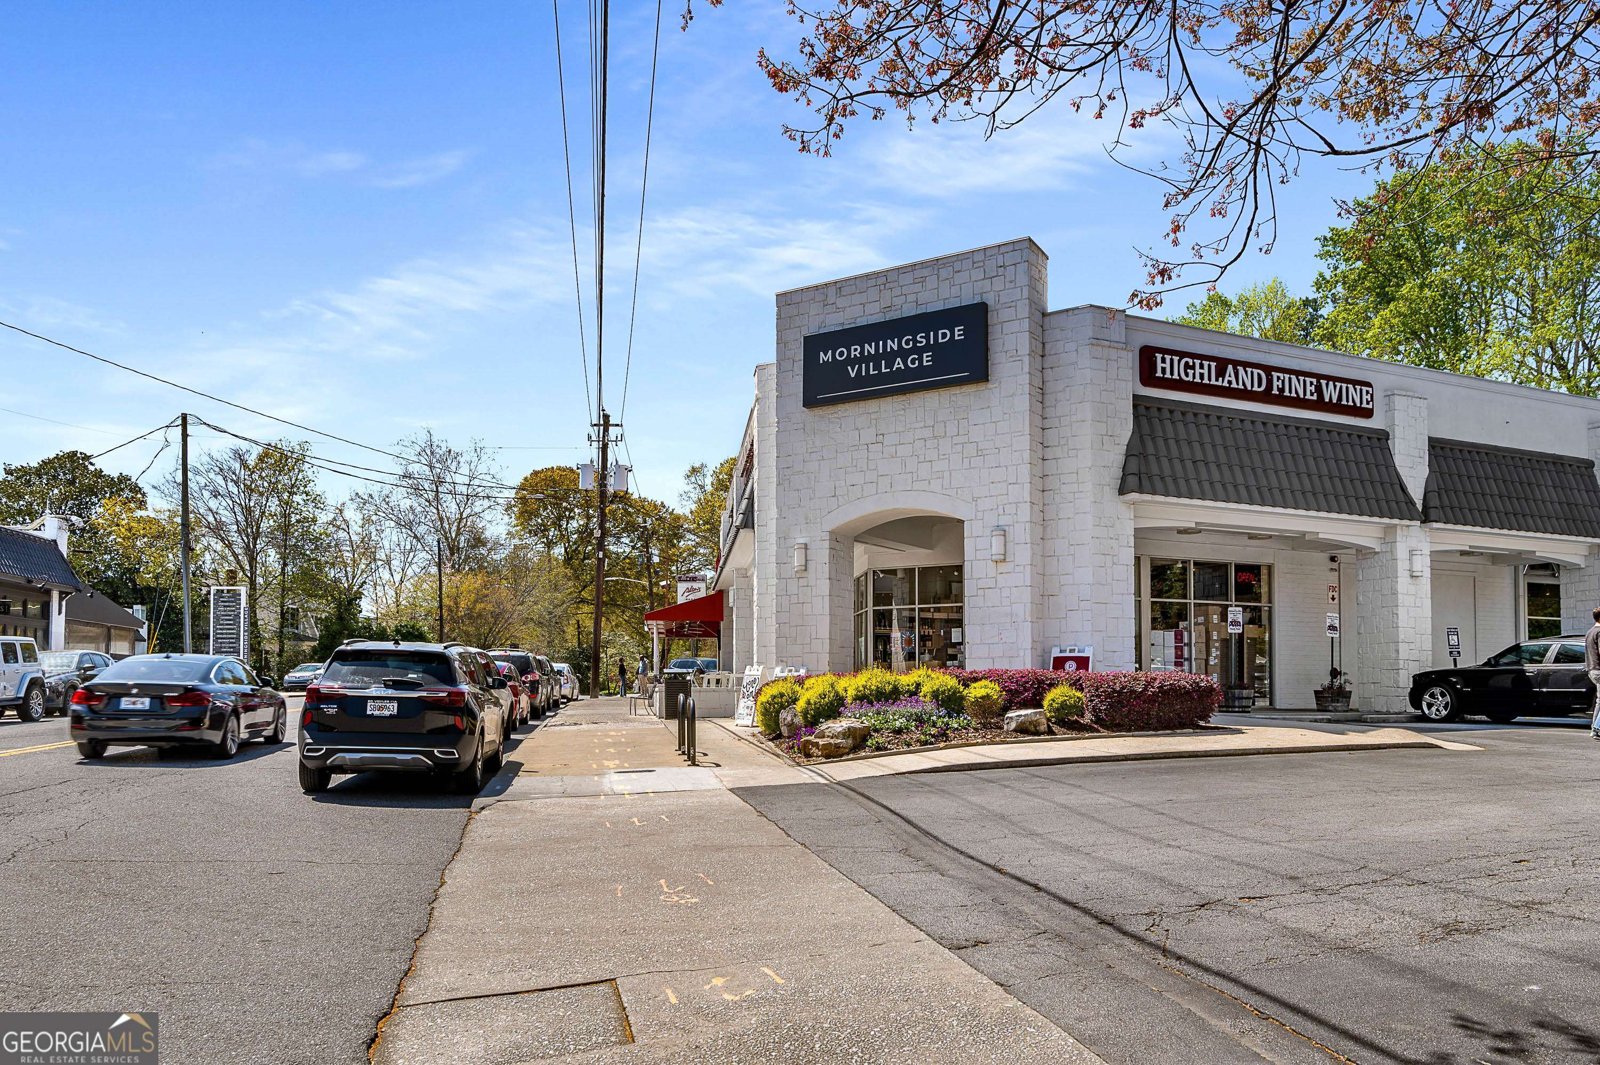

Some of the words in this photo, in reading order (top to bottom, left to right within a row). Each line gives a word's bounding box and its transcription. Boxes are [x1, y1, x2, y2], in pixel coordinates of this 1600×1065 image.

[819, 326, 965, 364] MORNINGSIDE
[847, 352, 934, 378] VILLAGE
[1154, 353, 1267, 392] HIGHLAND
[1271, 371, 1318, 400] FINE
[1319, 379, 1373, 409] WINE
[1237, 572, 1255, 582] OPEN
[1328, 585, 1338, 593] FDC
